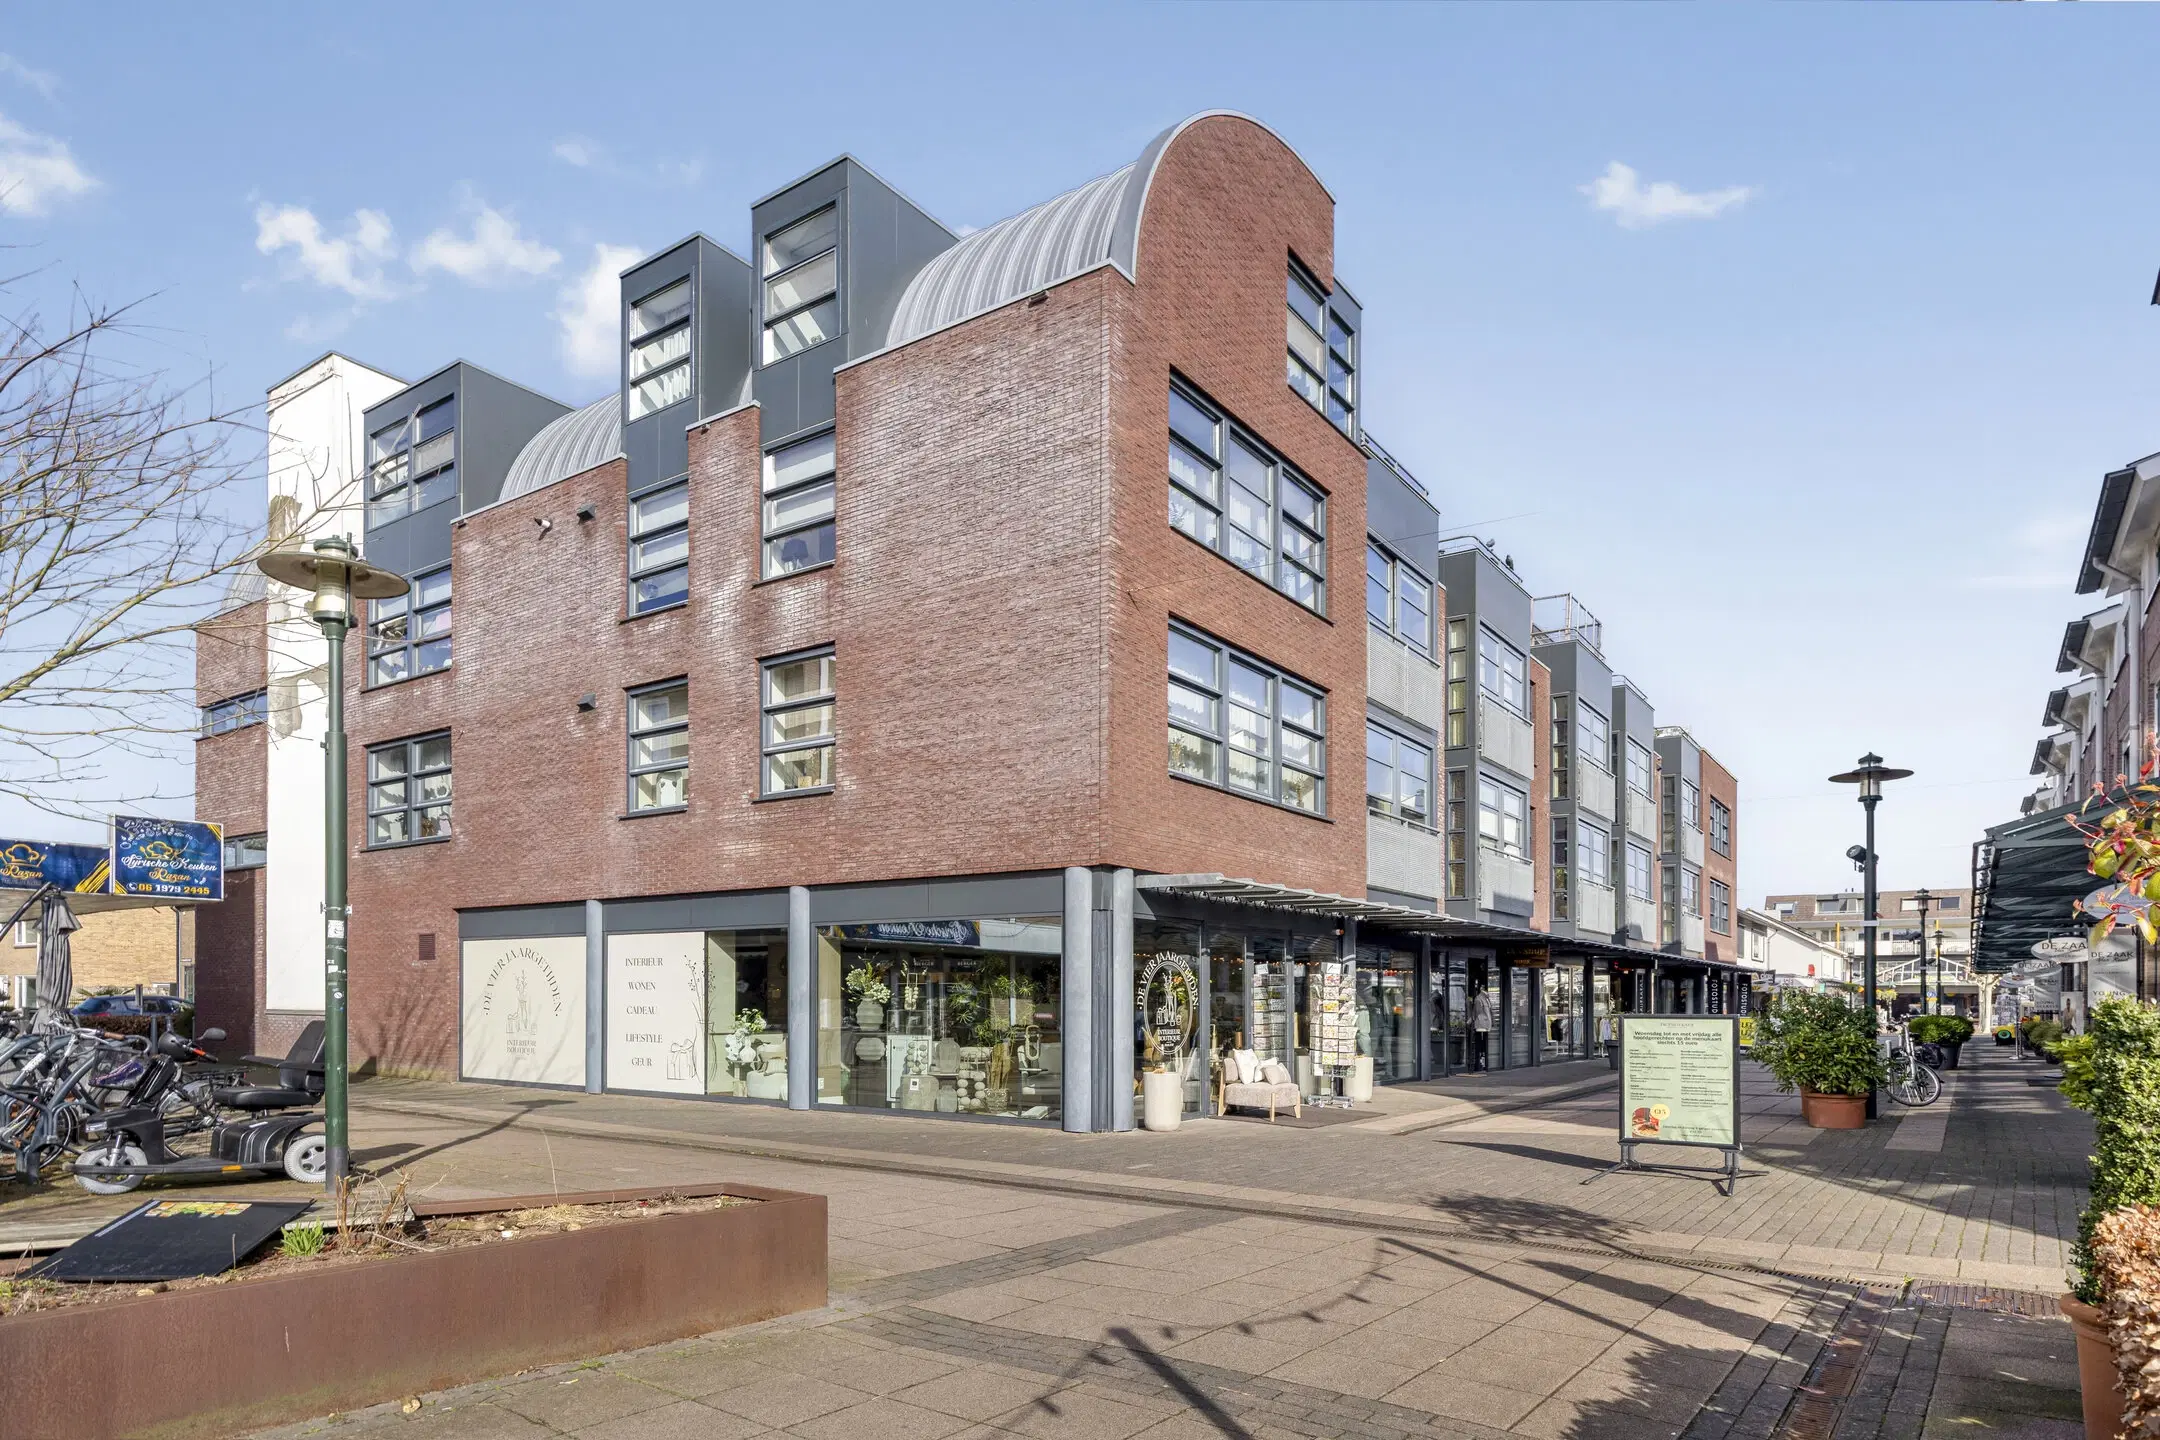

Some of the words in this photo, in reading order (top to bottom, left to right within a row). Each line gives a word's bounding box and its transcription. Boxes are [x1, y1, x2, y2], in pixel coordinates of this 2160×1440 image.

[121, 854, 168, 869] Syrische
[169, 858, 217, 871] Keuken
[0, 864, 44, 879] Razan
[149, 868, 191, 883] Razan
[138, 883, 152, 892] 06
[155, 884, 181, 893] 1979
[183, 886, 210, 895] 2445
[2041, 942, 2057, 950] DE
[625, 957, 664, 967] INTERIEUR
[1140, 959, 1157, 984] VIER
[627, 981, 656, 991] WONEN
[1137, 987, 1146, 1008] DE
[626, 1005, 658, 1015] CADEAU
[625, 1033, 663, 1043] LIFESTYLE
[631, 1056, 653, 1067] GEUR
